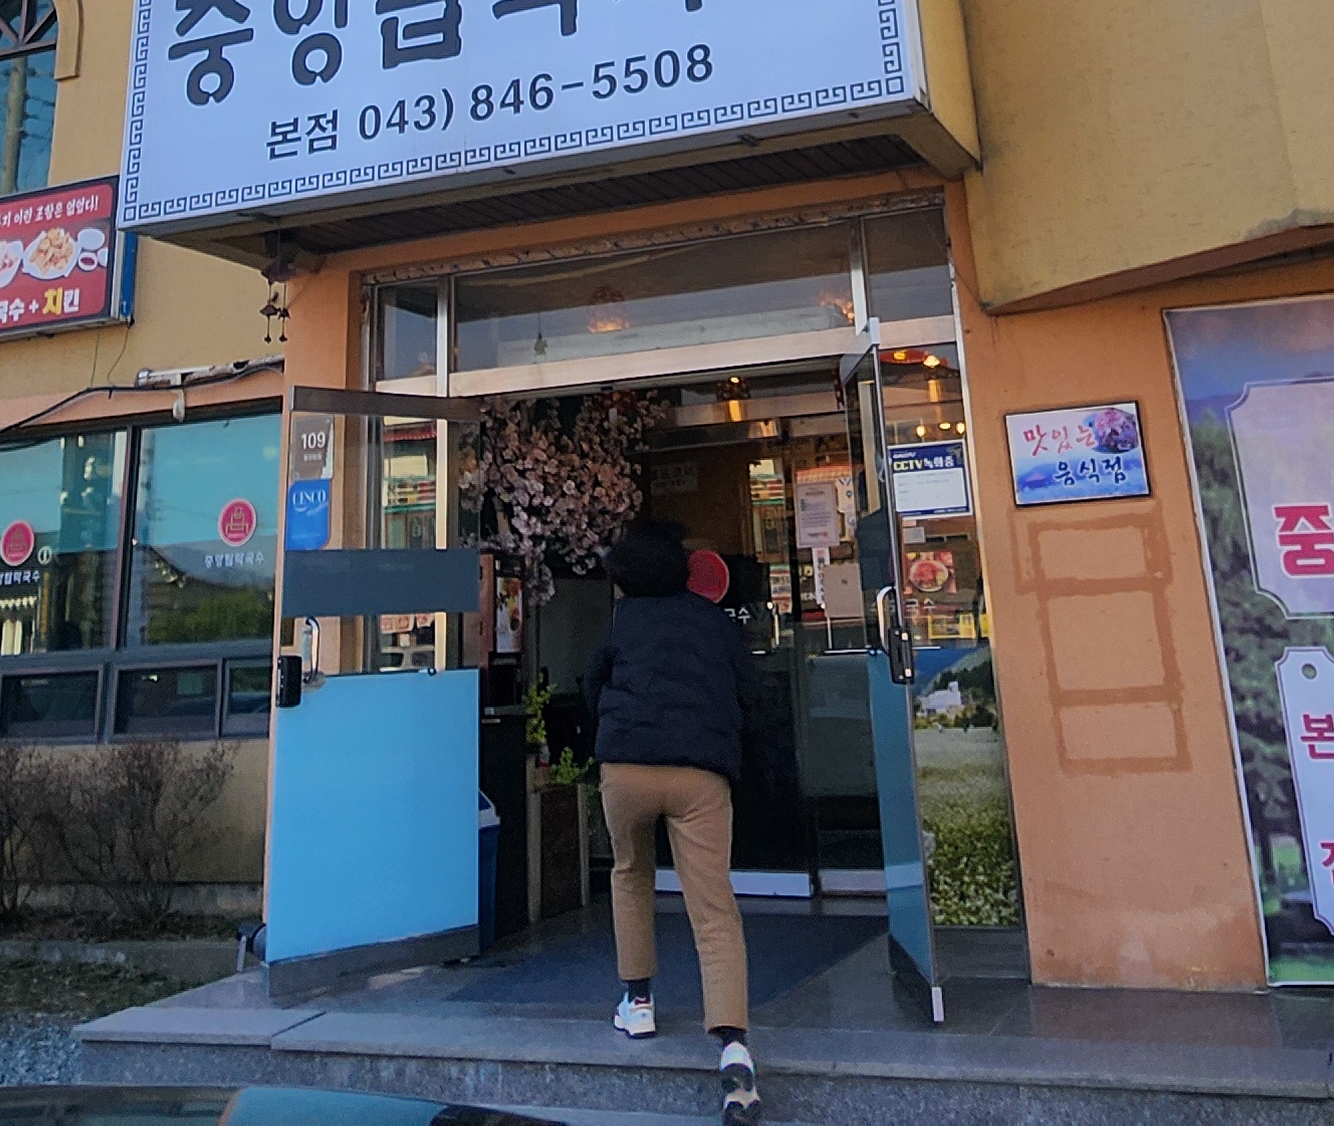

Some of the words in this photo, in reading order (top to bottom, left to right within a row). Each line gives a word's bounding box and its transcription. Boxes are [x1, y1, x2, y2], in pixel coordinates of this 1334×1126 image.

[266, 114, 340, 161] 본점
[14, 207, 33, 225] 이런
[35, 201, 63, 222] 조합은
[66, 195, 99, 216] 없었다!
[42, 286, 80, 315] 치킨
[301, 431, 326, 449] 109
[1023, 424, 1096, 456] 맛있는
[1054, 456, 1126, 486] 음식점
